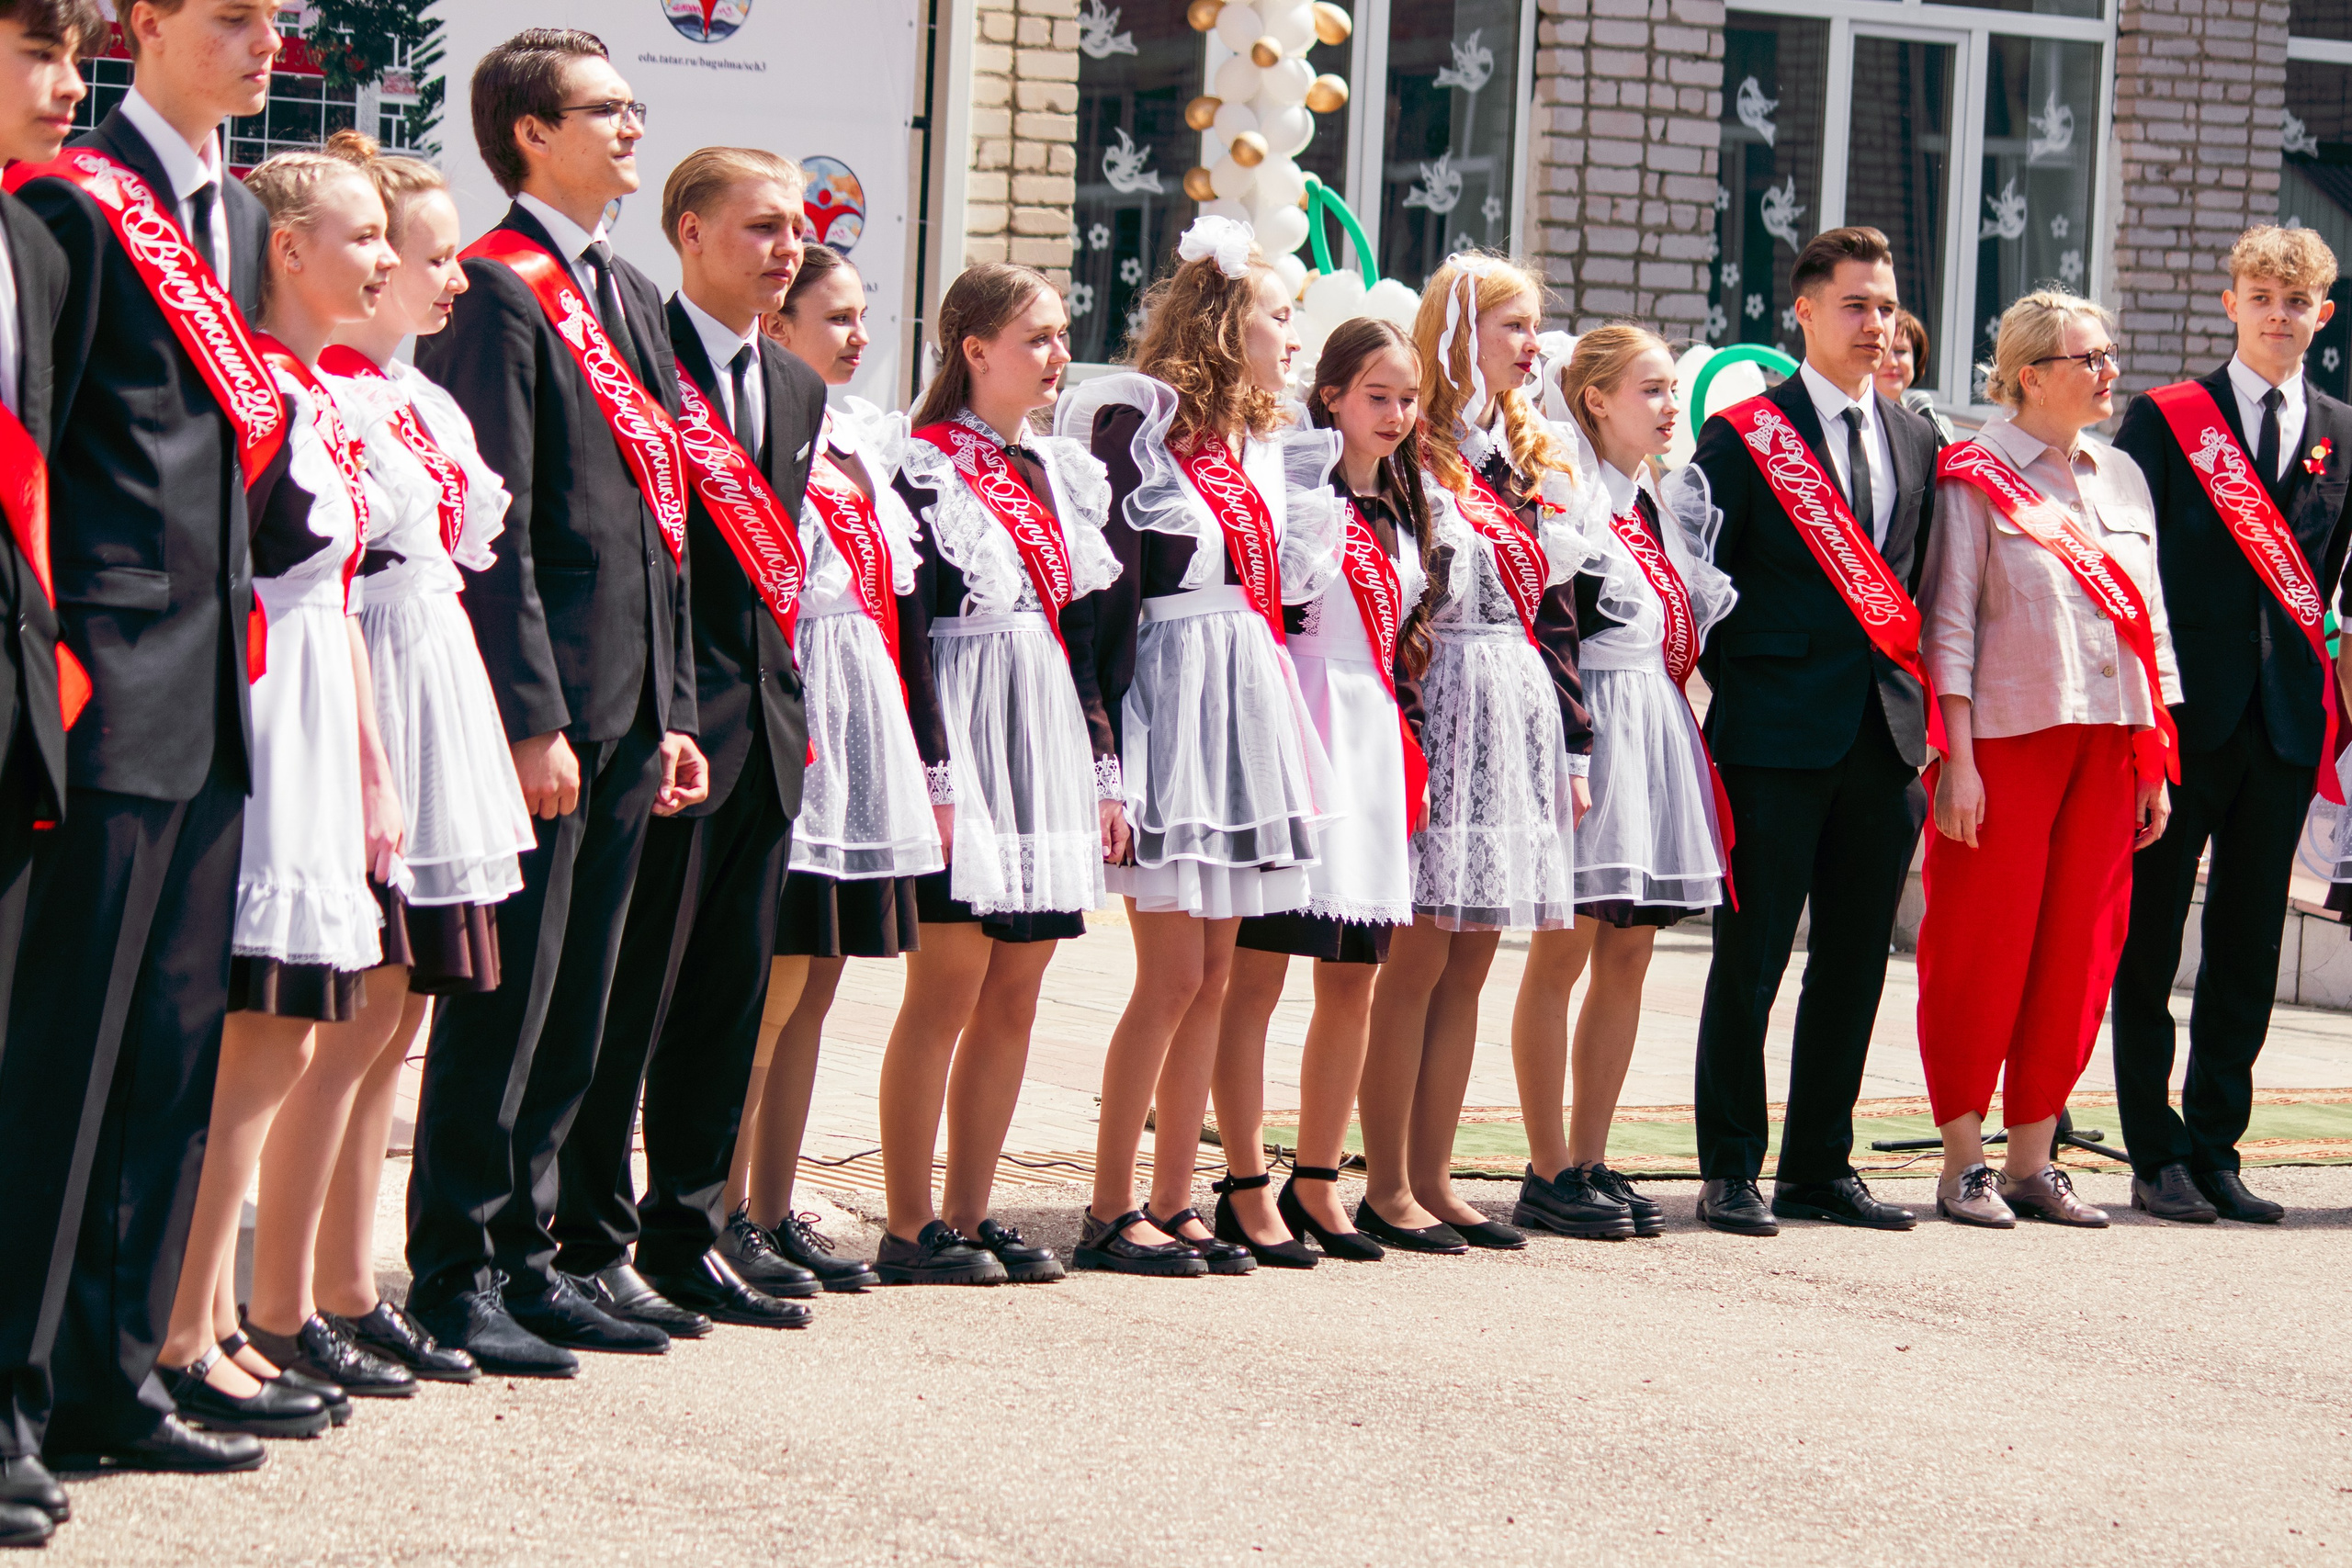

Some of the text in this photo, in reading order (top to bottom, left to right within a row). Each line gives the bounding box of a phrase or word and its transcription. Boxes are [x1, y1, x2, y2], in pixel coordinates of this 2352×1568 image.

[121, 204, 257, 390] Выпускник
[584, 348, 674, 503] Выпускник
[678, 416, 786, 568] Выпускник
[1192, 455, 1266, 598] Выпускница
[1618, 524, 1688, 655] Выпускница
[1767, 453, 1906, 626] Выпускник 2025
[2210, 471, 2322, 626] Выпускник 2025
